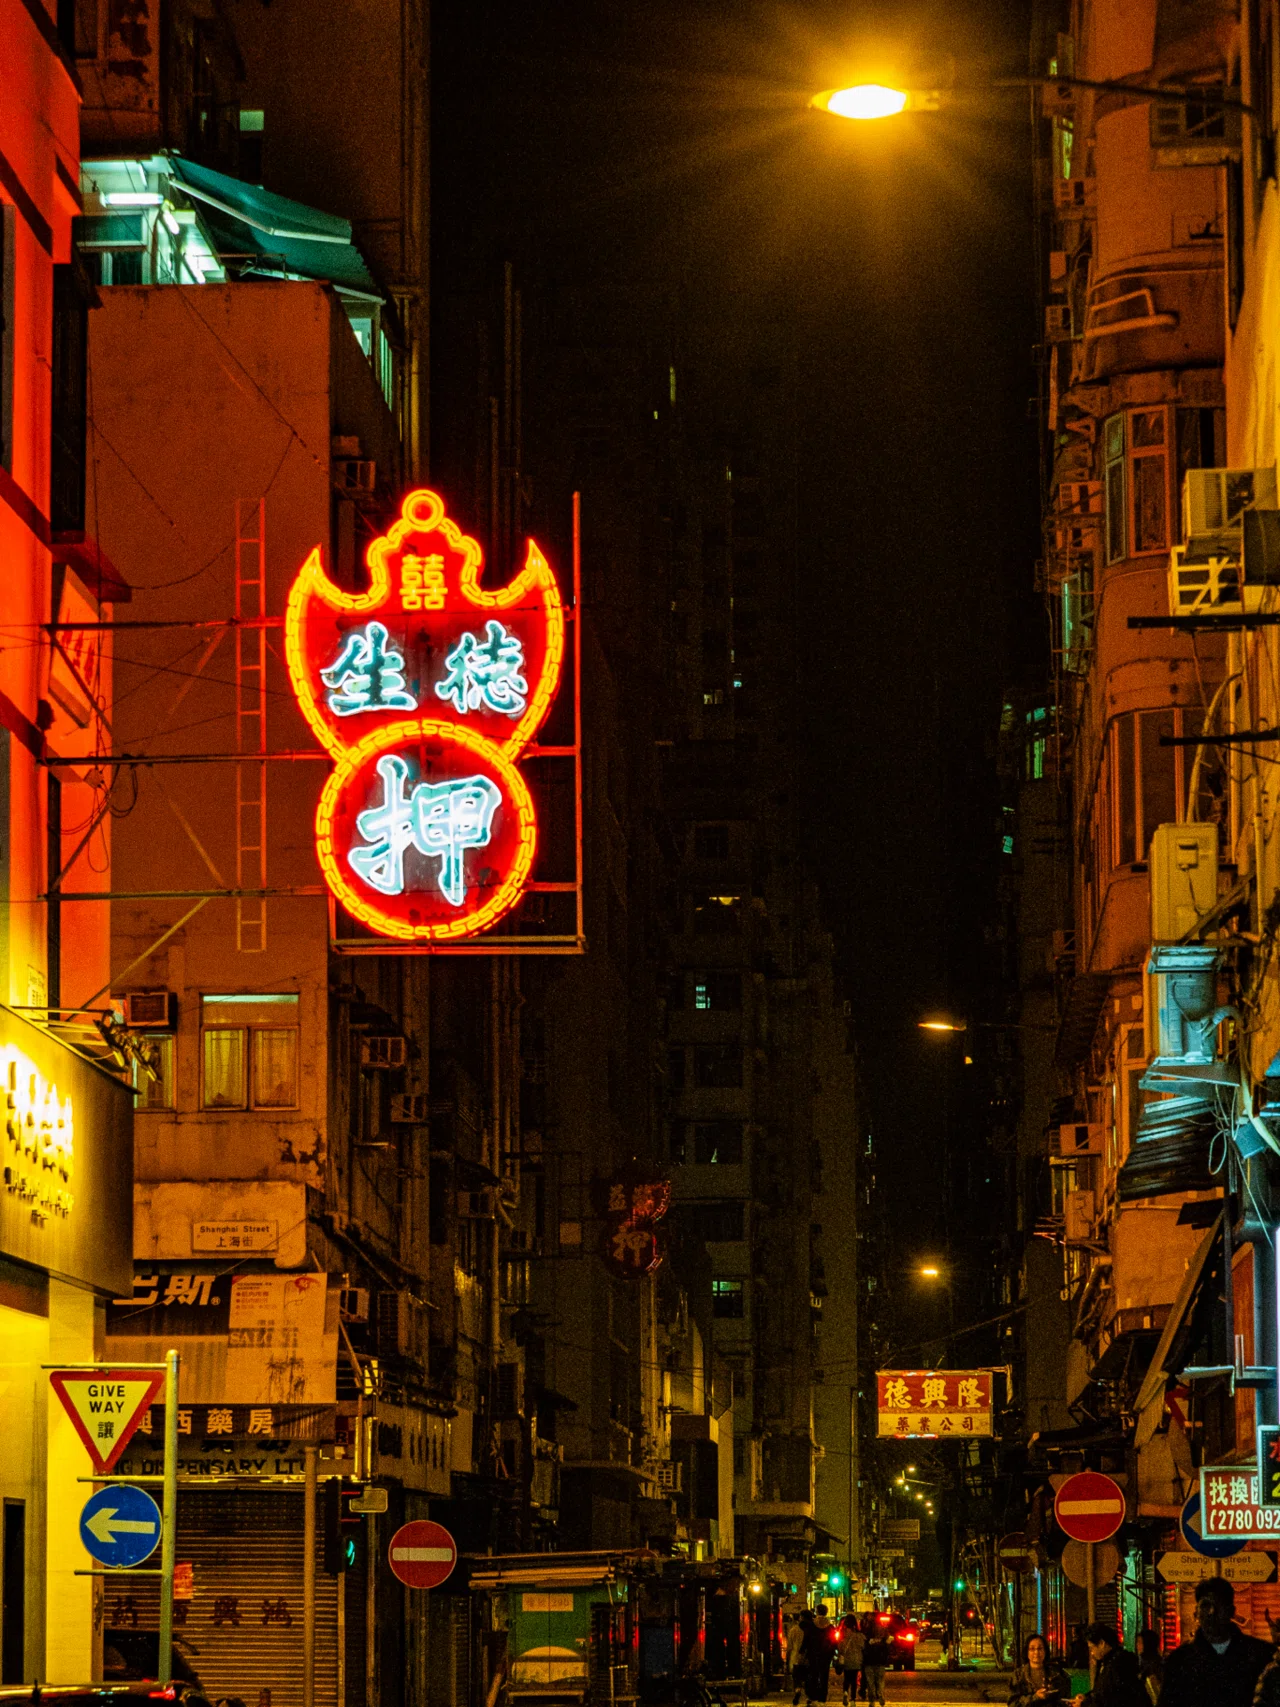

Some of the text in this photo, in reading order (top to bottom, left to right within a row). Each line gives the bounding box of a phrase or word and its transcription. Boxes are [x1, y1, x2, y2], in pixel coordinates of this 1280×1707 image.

[348, 754, 503, 907] 押
[200, 1225, 270, 1234] Shanghai Street
[216, 1236, 253, 1247] 上海街
[88, 1384, 125, 1397] GIVE
[884, 1377, 985, 1409] 德興隆
[89, 1401, 125, 1413] WAY
[98, 1421, 115, 1439] 讓
[896, 1416, 974, 1432] 藥業公司
